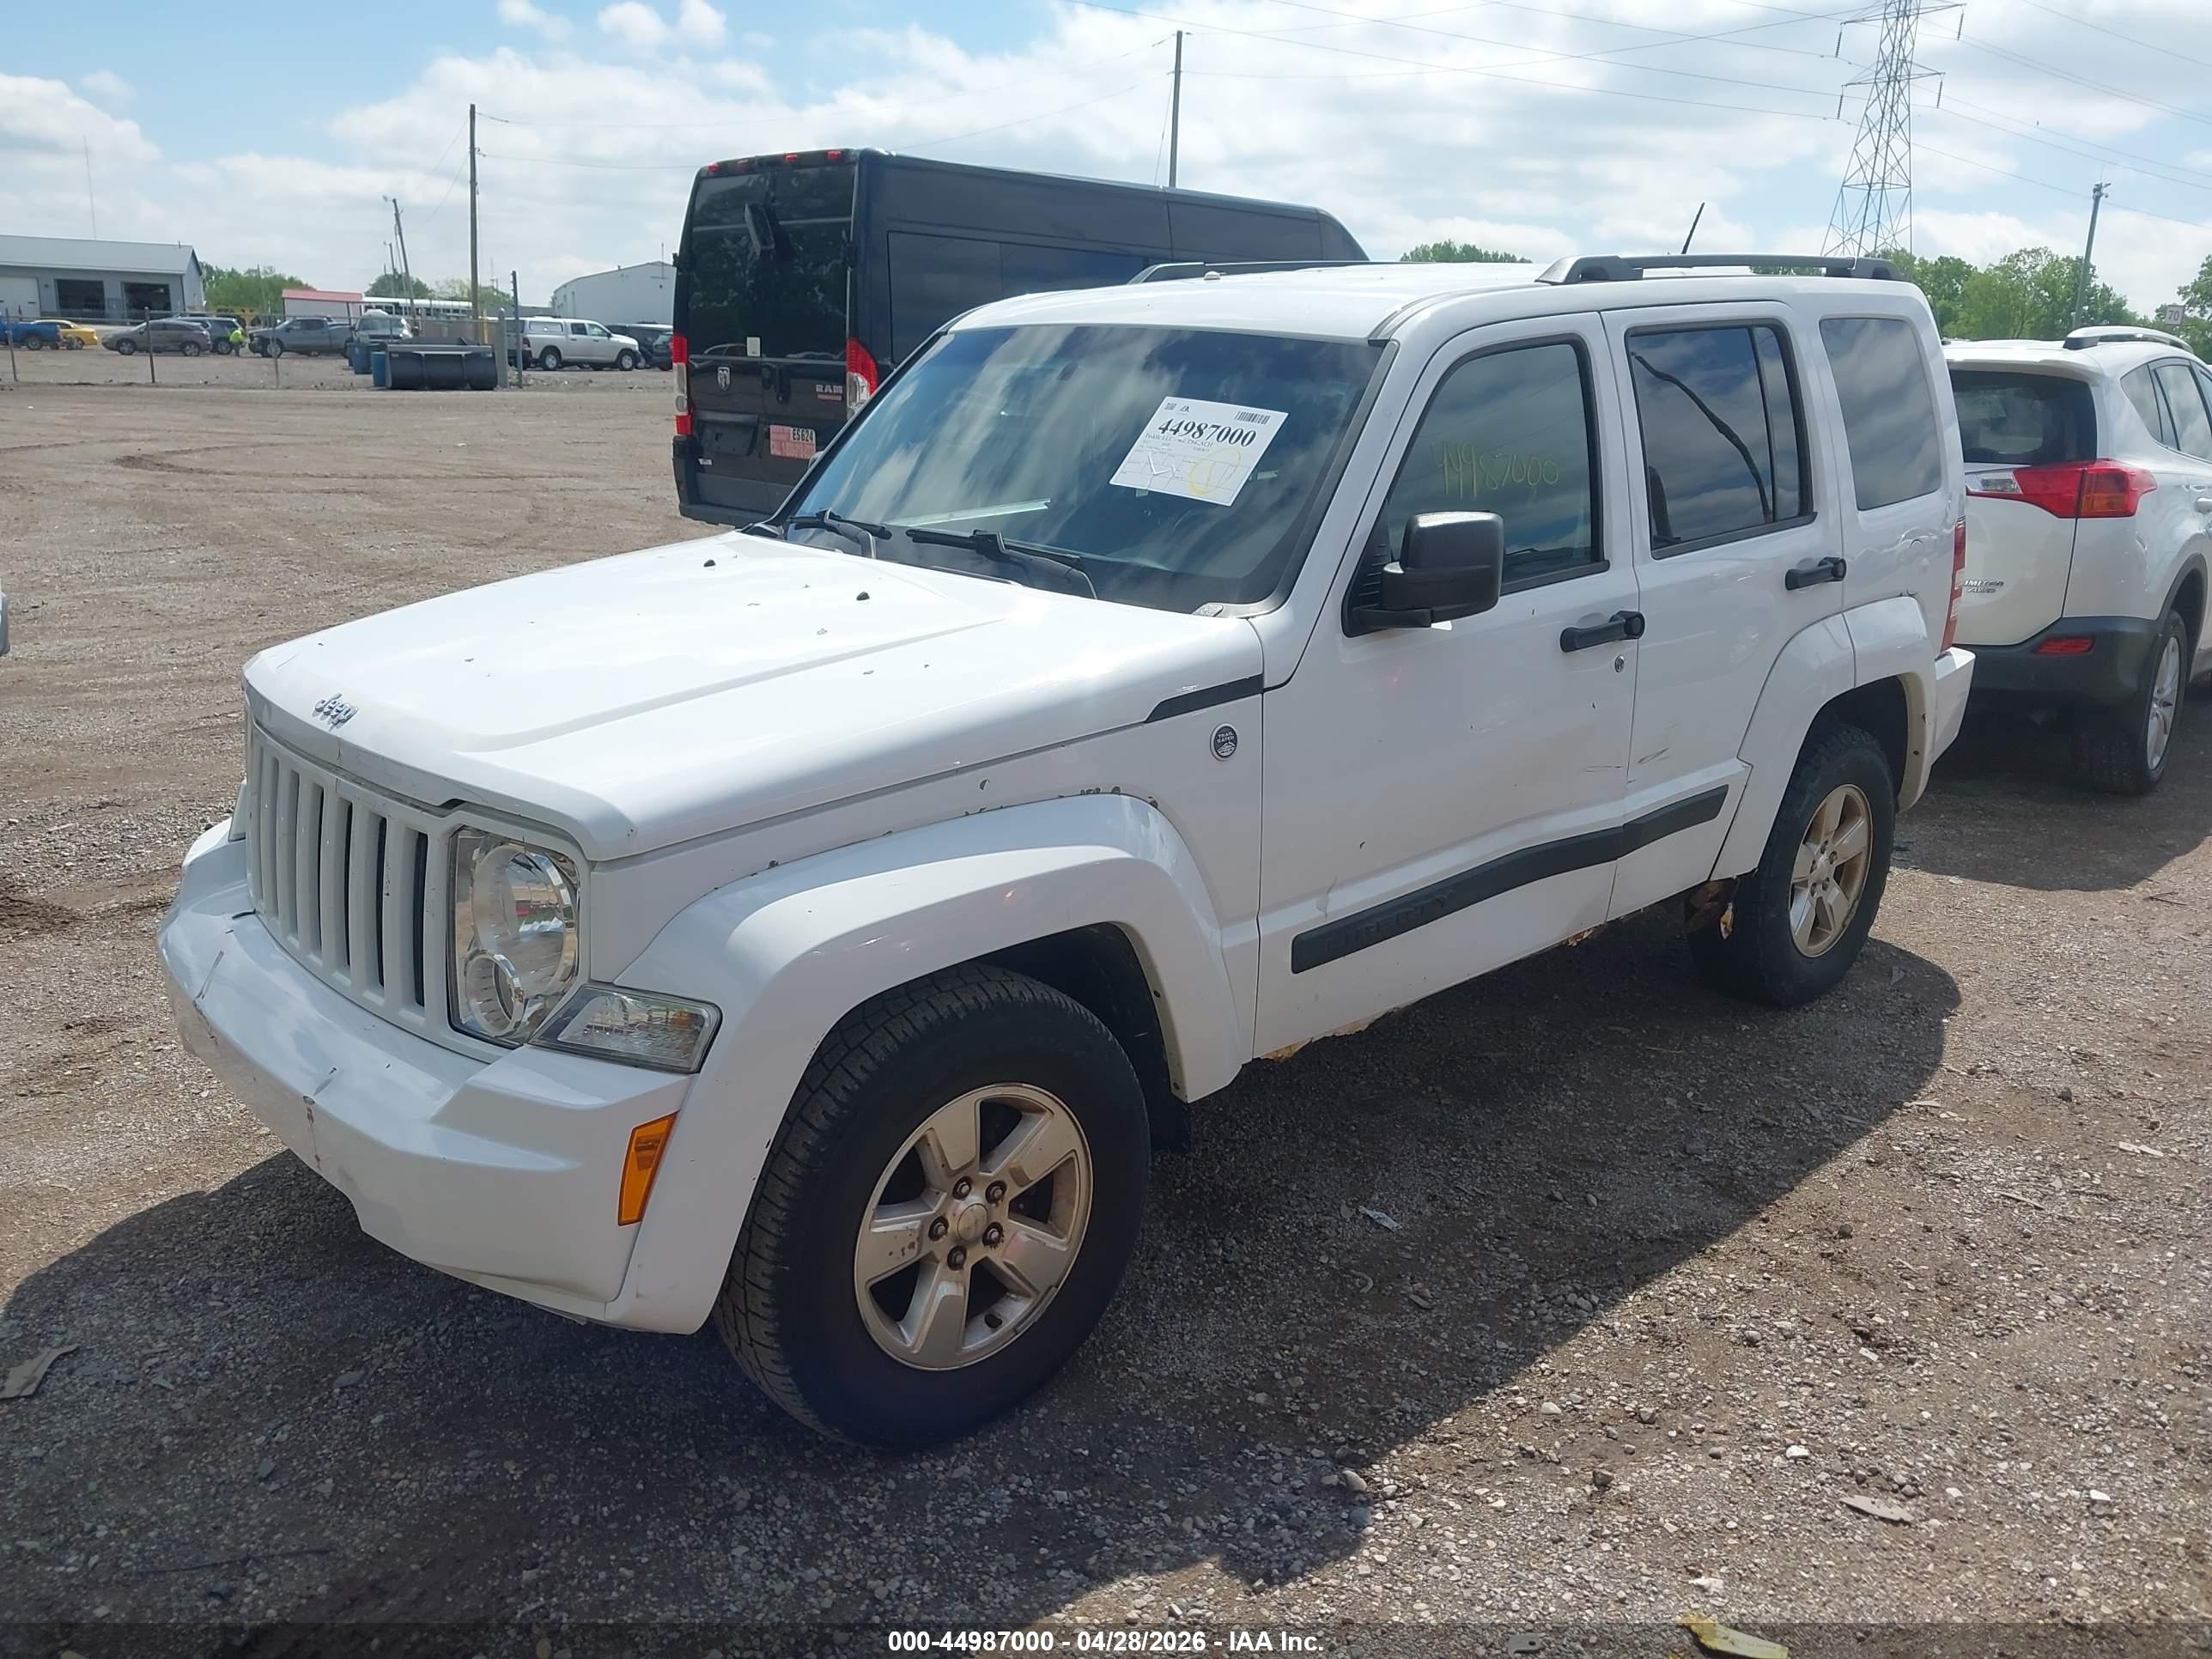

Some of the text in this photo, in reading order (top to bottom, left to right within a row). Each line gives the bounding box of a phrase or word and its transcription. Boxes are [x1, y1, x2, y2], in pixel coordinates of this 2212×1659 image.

[2168, 310, 2179, 320] 70
[816, 384, 843, 394] RAM
[793, 428, 813, 442] ES624
[1158, 418, 1257, 447] 44987000
[315, 692, 359, 726] Jeep
[1217, 736, 1235, 744] RATED
